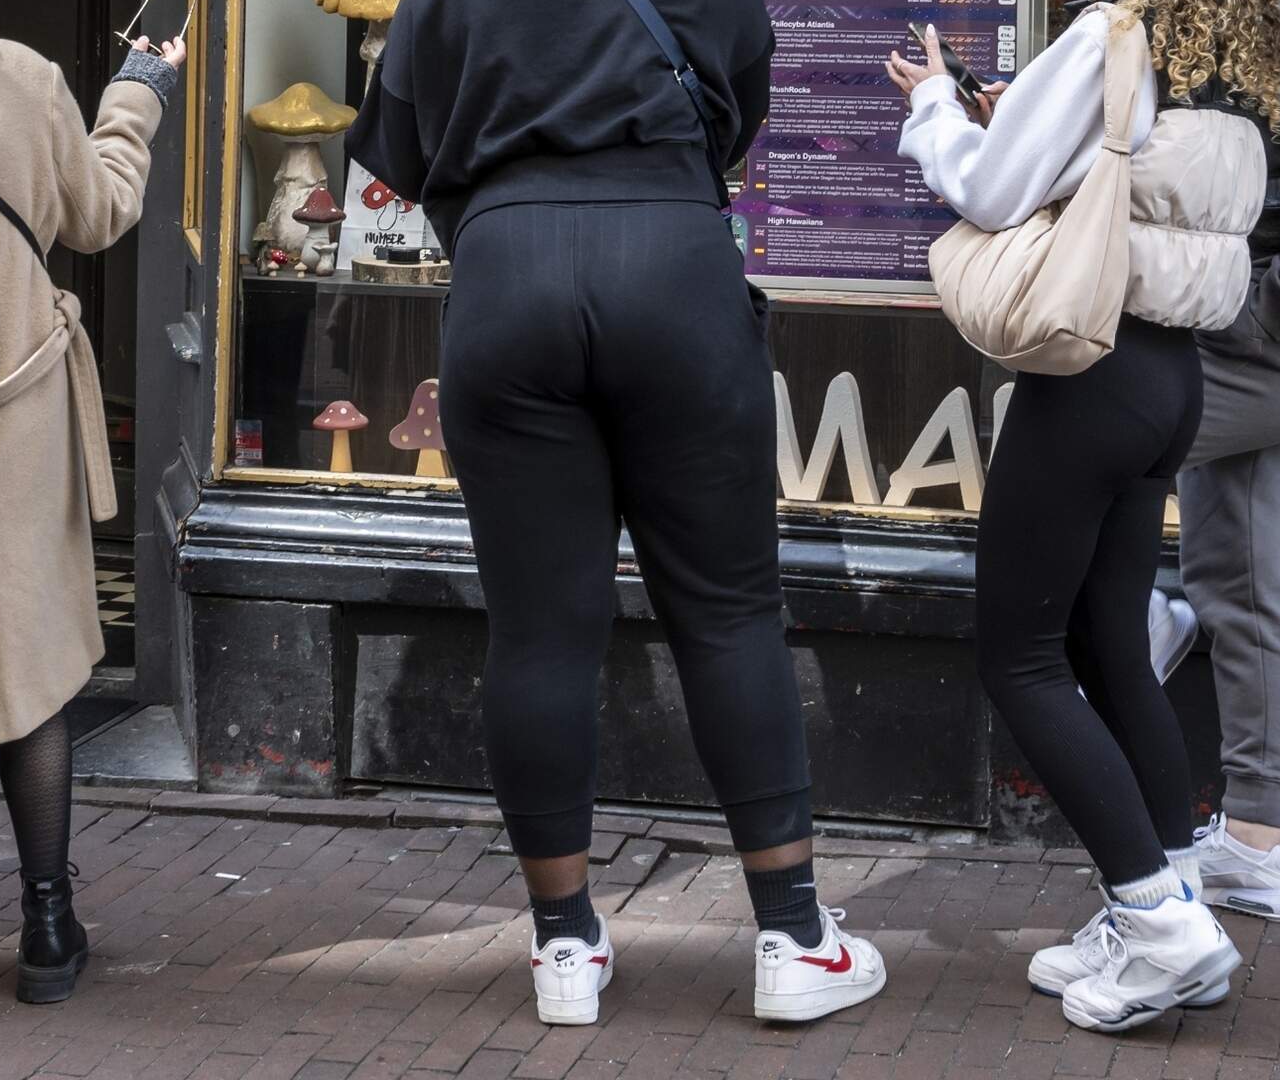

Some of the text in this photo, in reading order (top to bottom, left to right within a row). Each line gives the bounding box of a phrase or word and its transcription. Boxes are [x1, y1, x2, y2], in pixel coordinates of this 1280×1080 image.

[770, 20, 835, 30] Psilocybe Atlantis
[769, 85, 812, 94] MushRocks
[768, 151, 838, 161] Dragon's Dynamite
[767, 217, 824, 227] High Hawaiians
[364, 231, 407, 245] NUMBER
